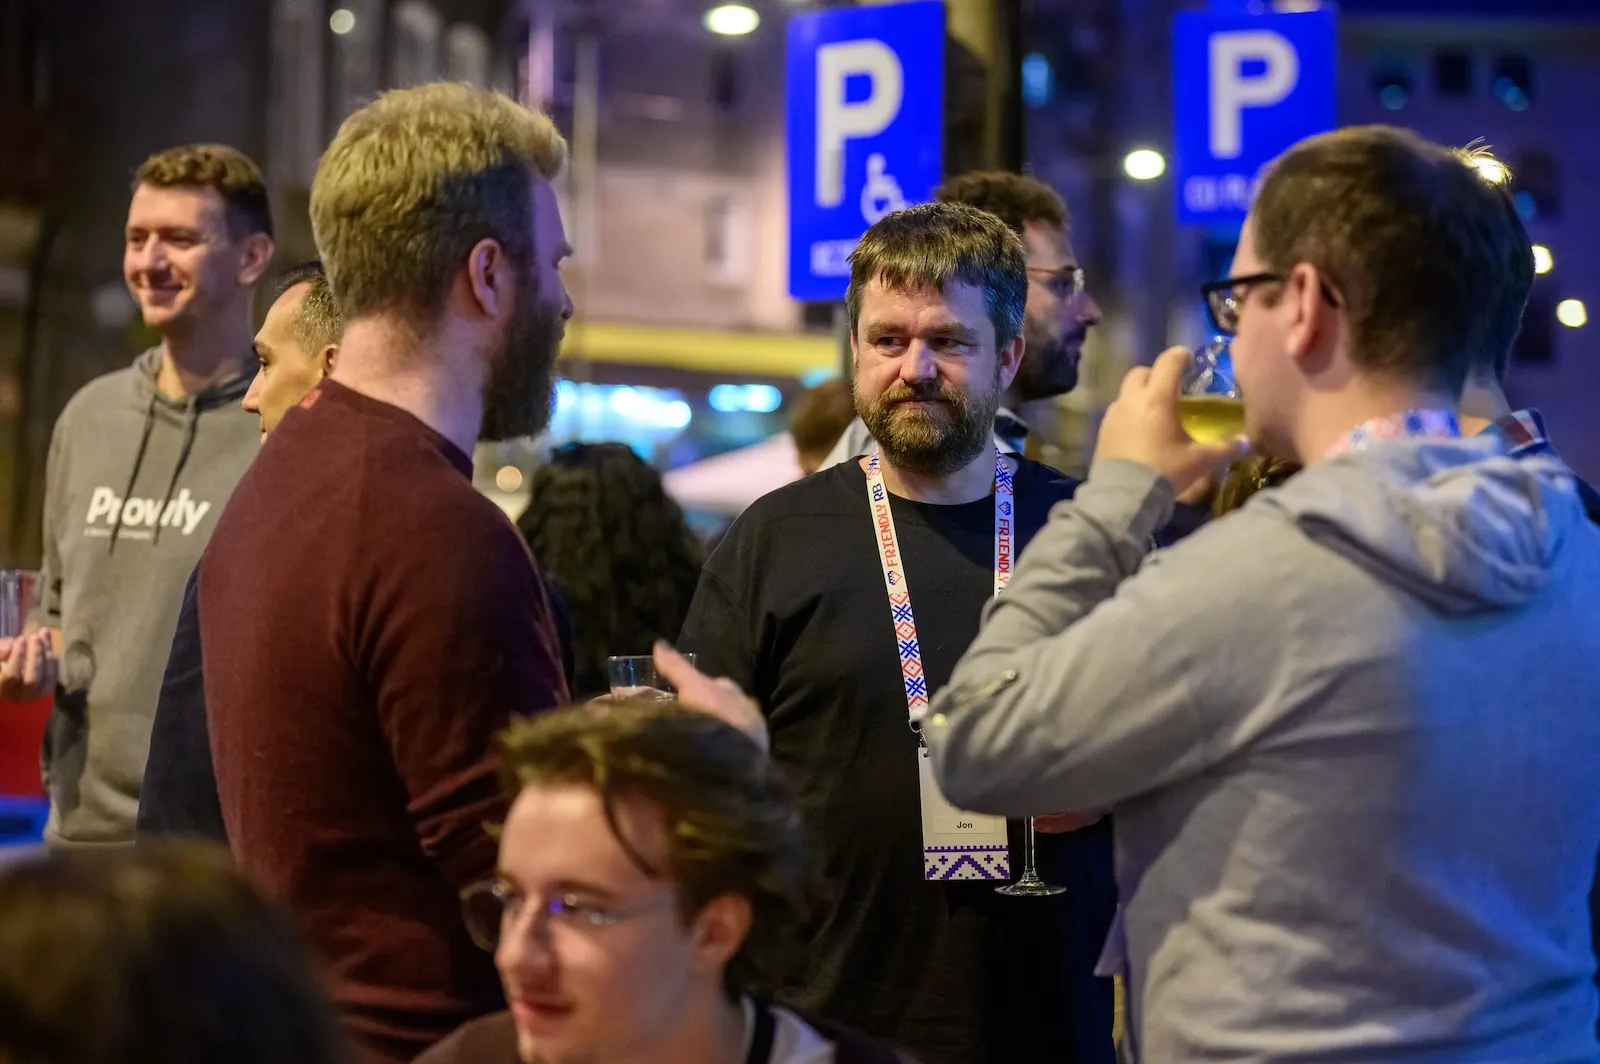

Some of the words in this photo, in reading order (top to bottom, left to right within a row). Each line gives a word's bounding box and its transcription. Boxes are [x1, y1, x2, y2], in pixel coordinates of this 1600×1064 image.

[815, 39, 904, 208] P
[1208, 29, 1300, 160] P
[86, 486, 212, 536] Prowly
[872, 483, 884, 502] RB
[876, 504, 898, 567] FRIENDLY
[998, 518, 1010, 585] FRIENDLY
[956, 821, 973, 829] Jon
